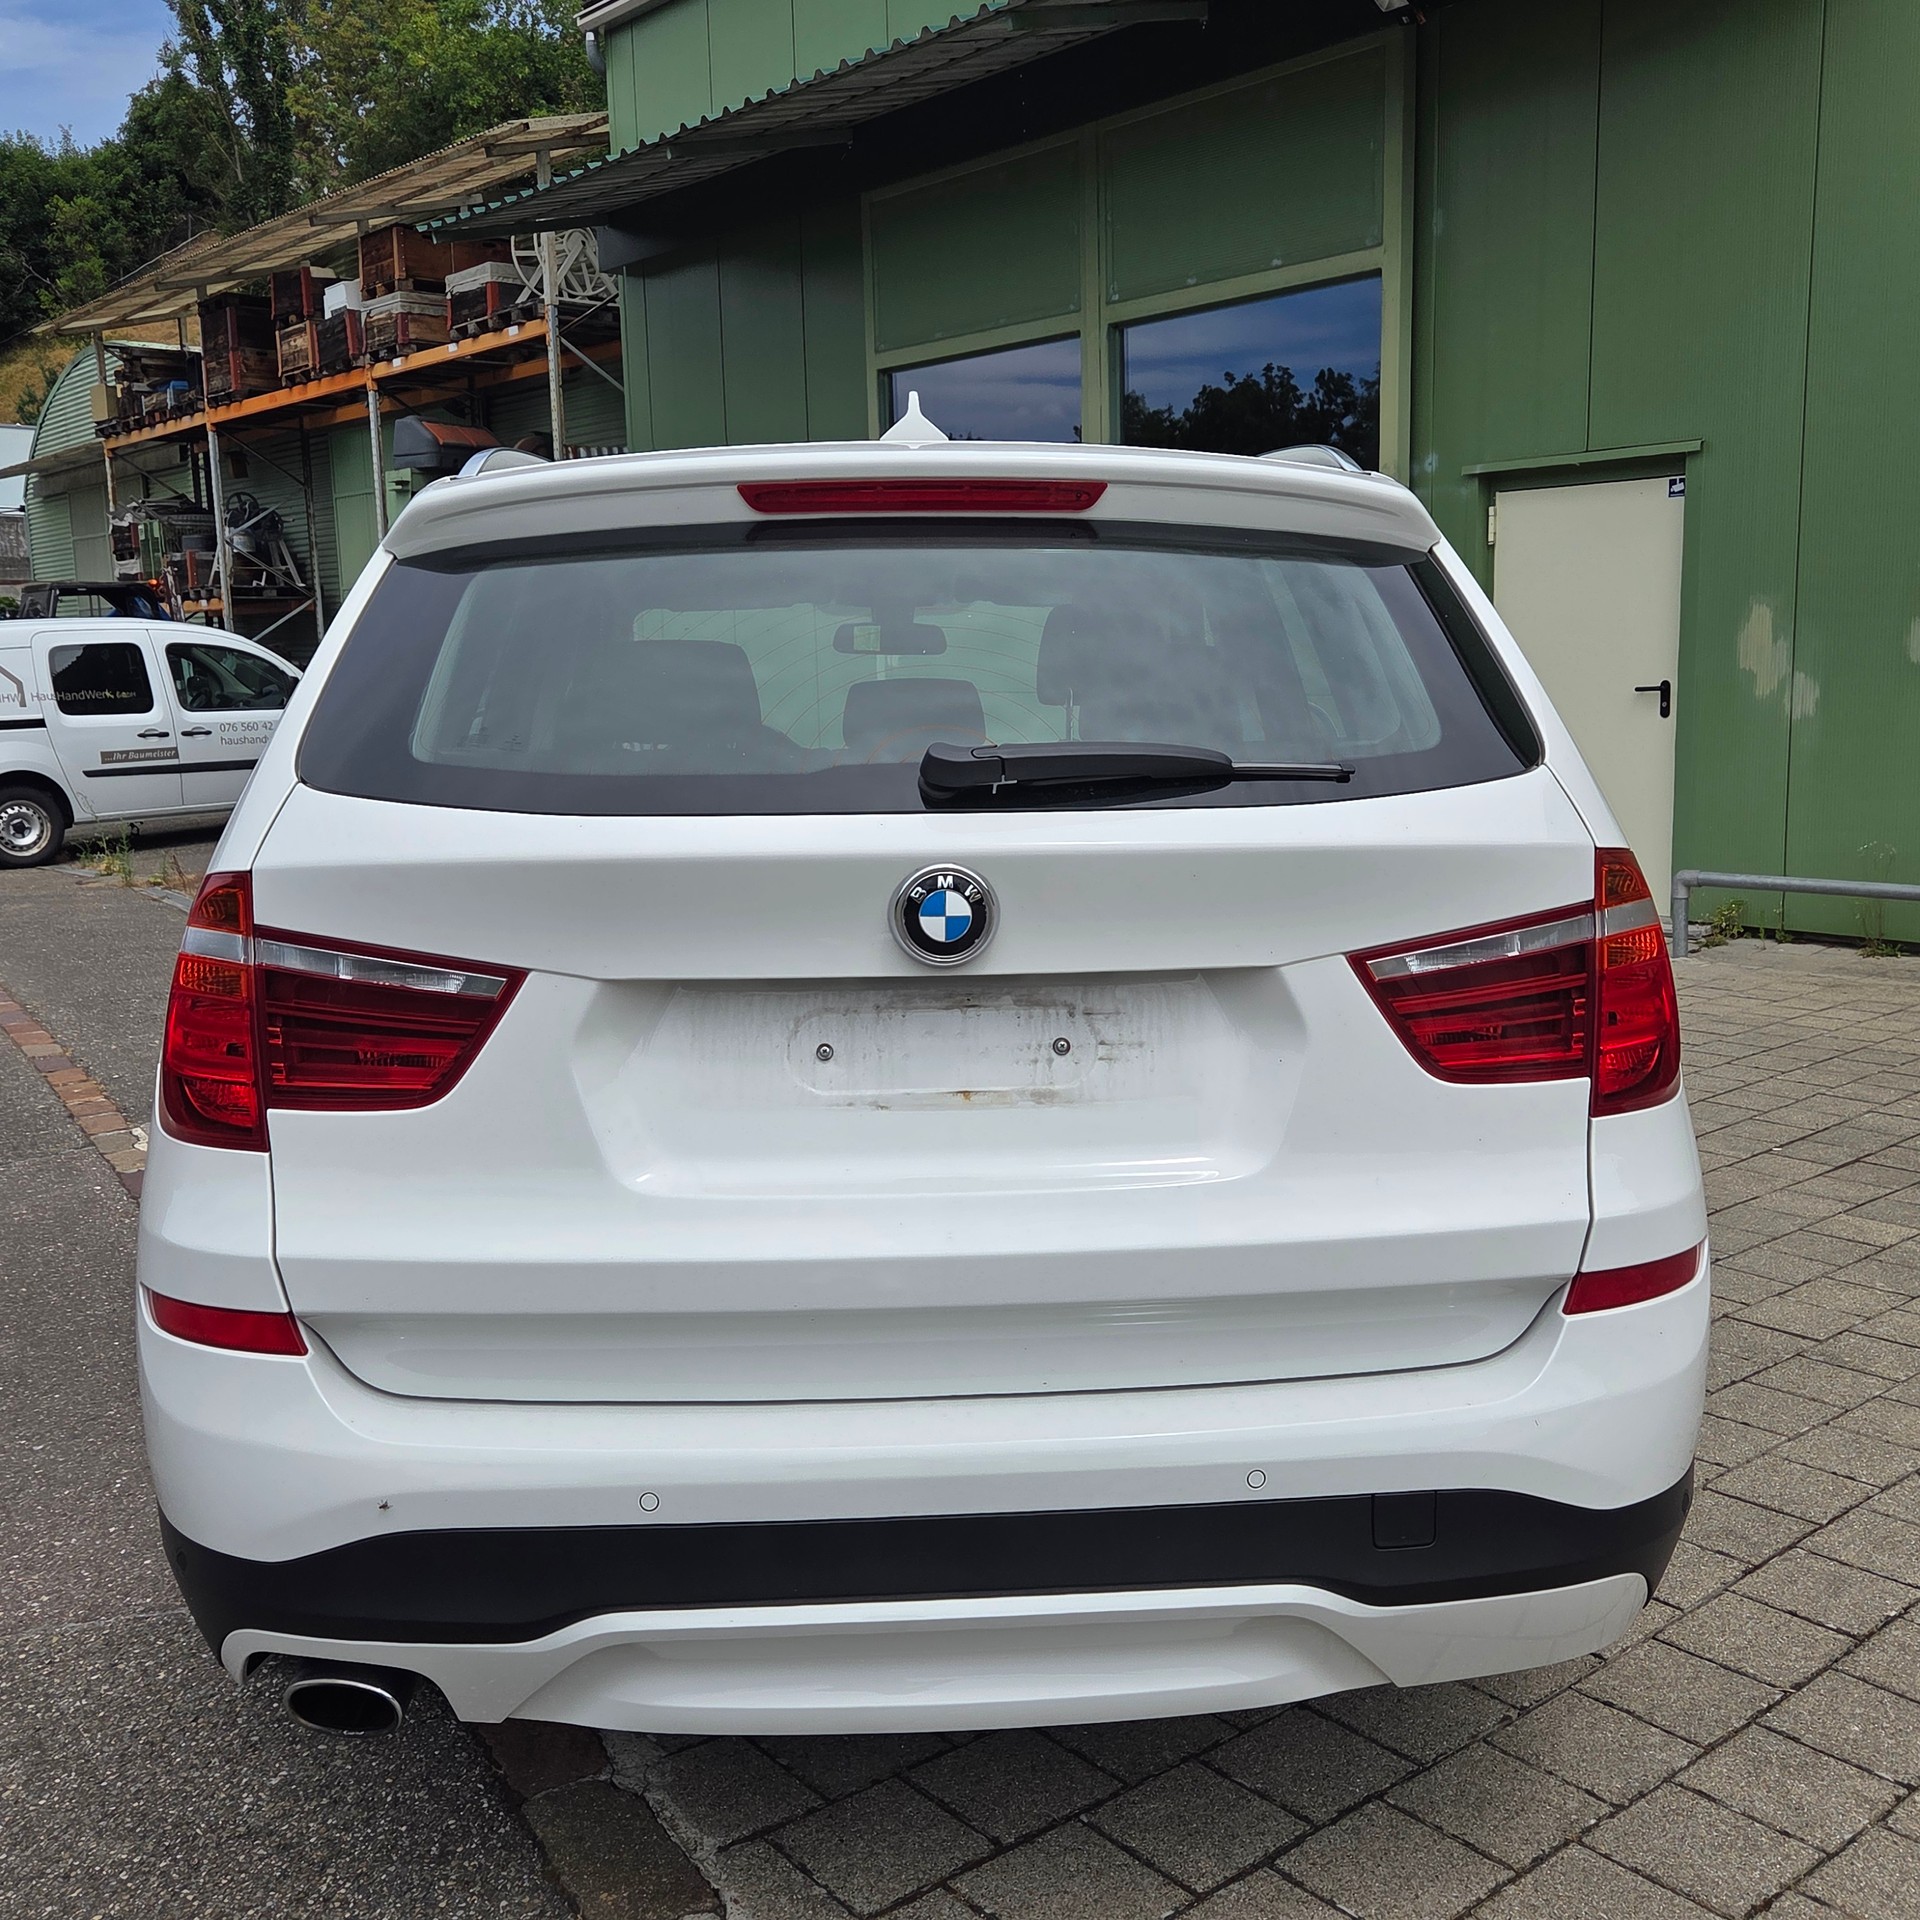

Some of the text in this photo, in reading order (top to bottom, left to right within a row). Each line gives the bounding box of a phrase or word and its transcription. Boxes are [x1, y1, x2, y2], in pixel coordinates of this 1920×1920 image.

[0, 693, 21, 703] HW
[30, 689, 115, 702] HausHandWerk
[220, 721, 274, 732] 076 560 42
[220, 735, 269, 745] haushand
[128, 750, 176, 760] Baumeister
[909, 875, 982, 904] BMW
